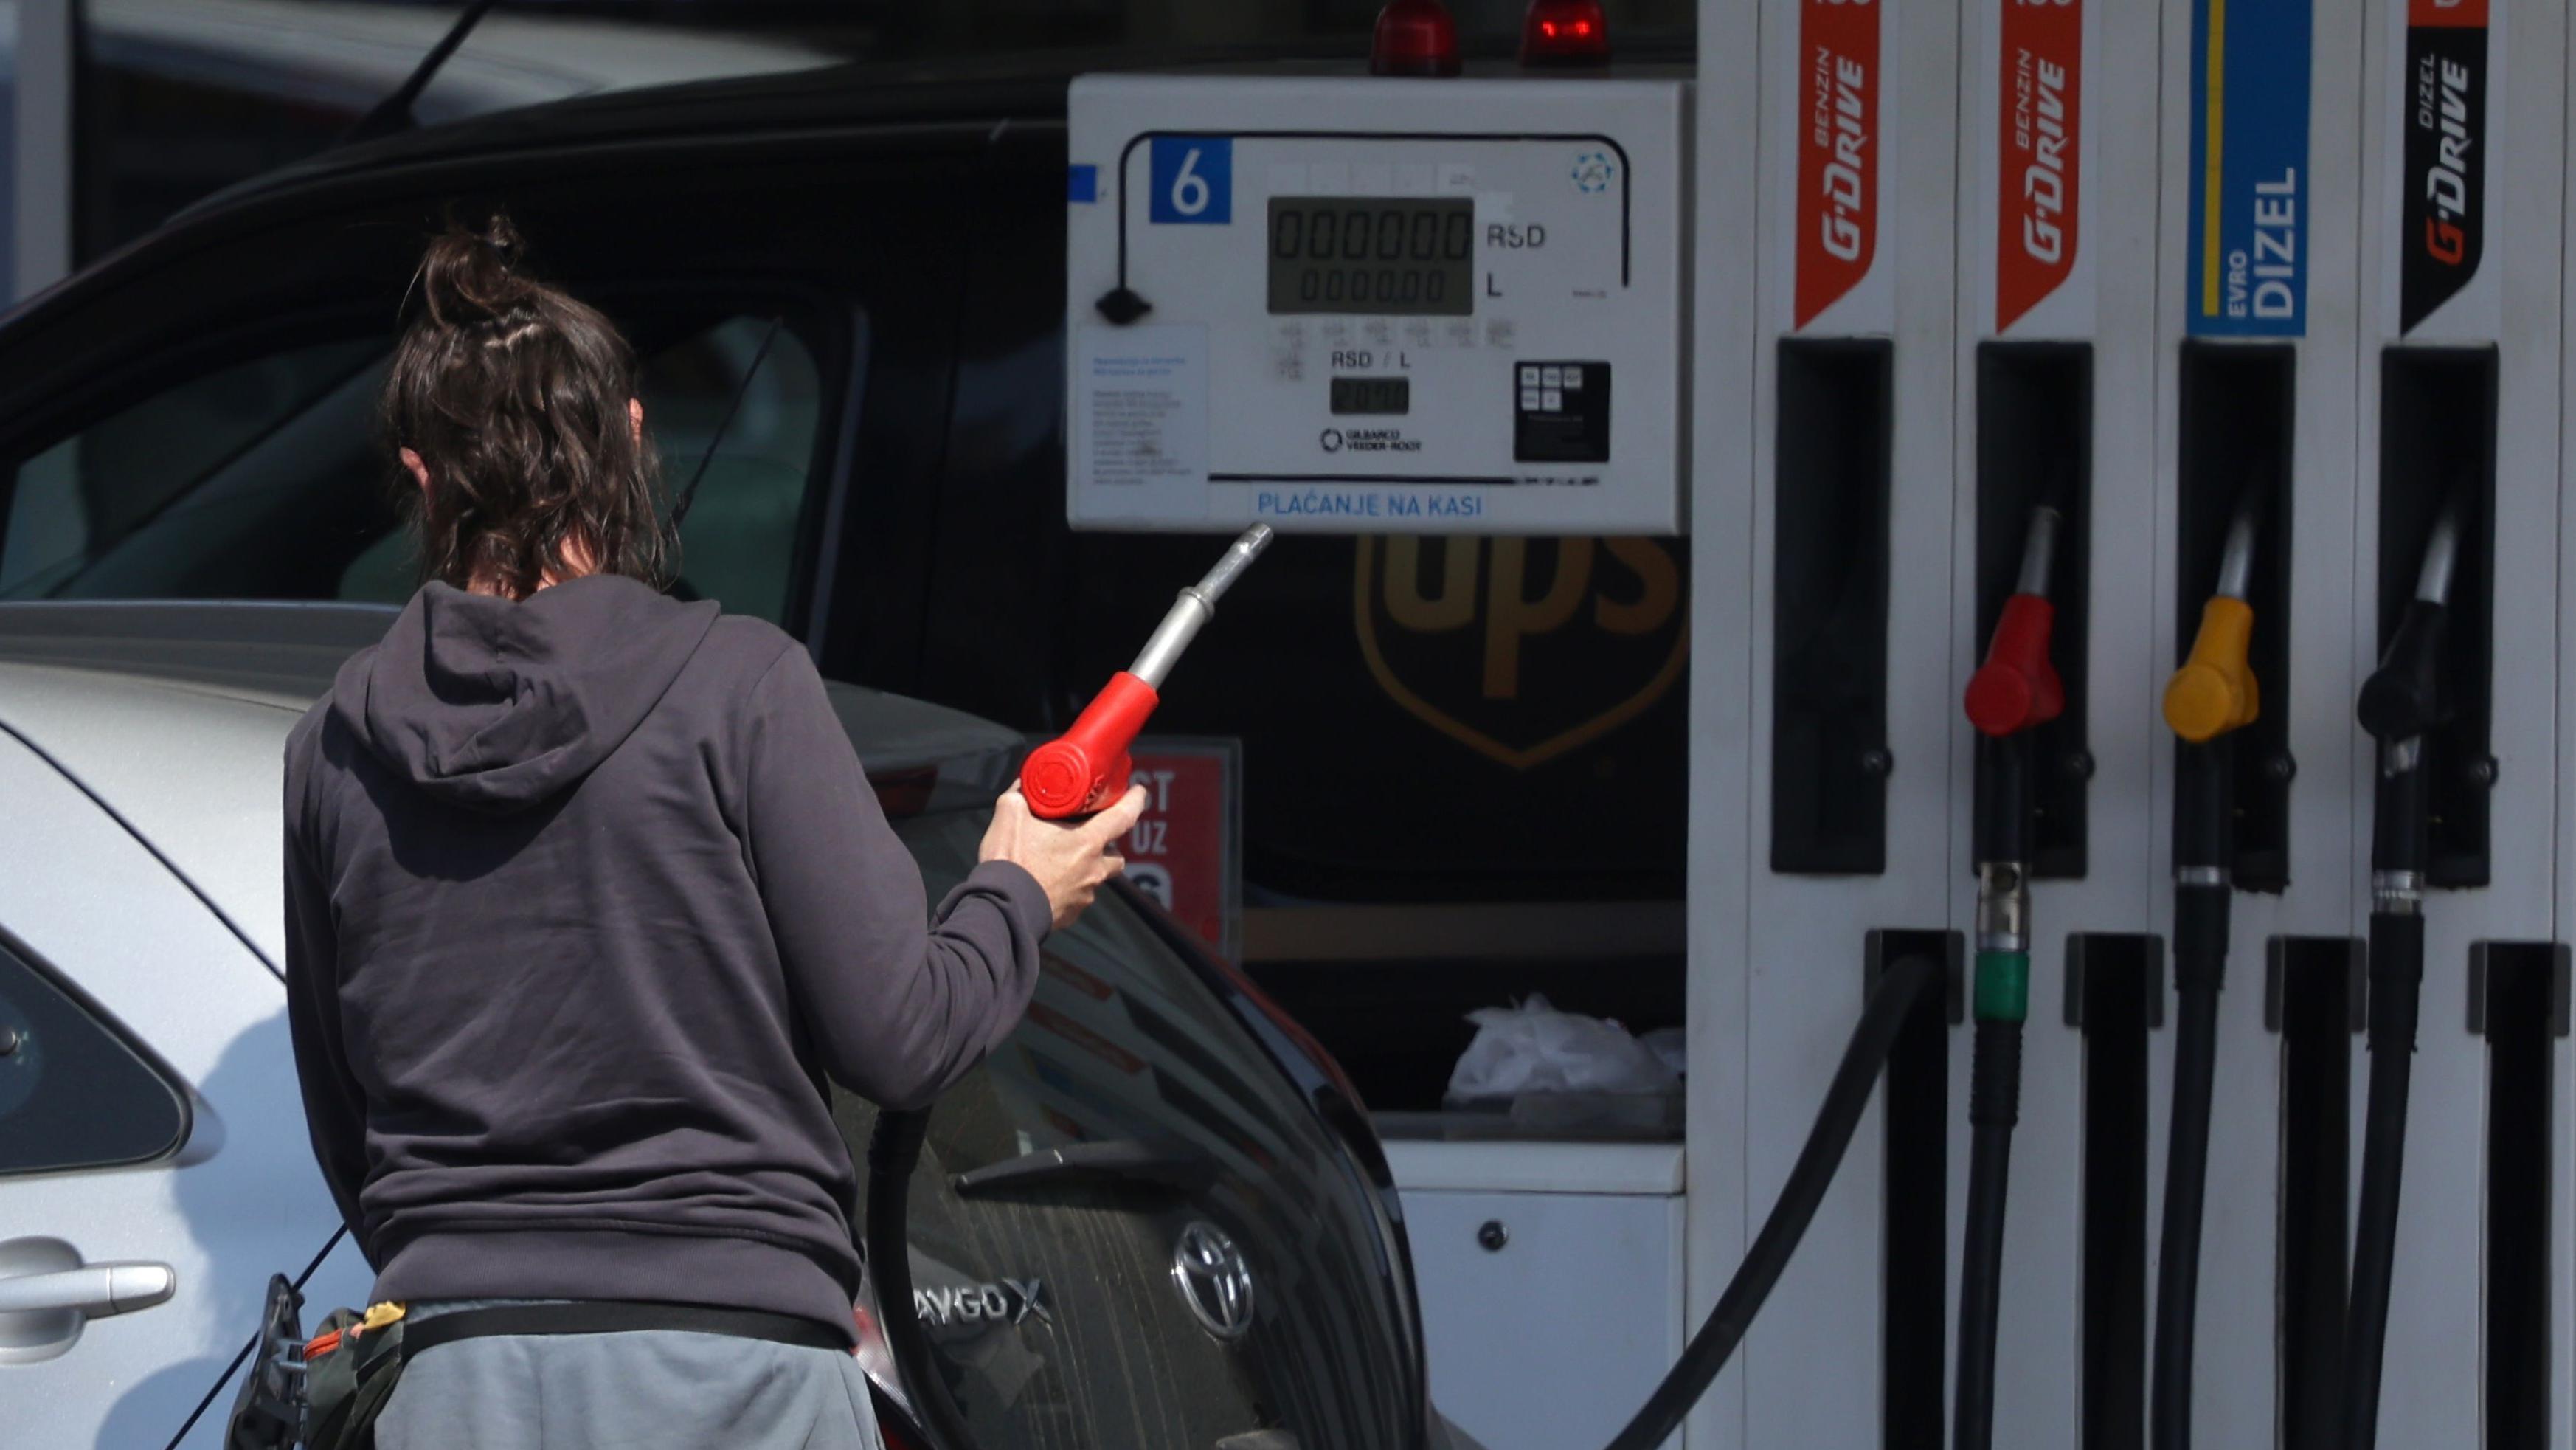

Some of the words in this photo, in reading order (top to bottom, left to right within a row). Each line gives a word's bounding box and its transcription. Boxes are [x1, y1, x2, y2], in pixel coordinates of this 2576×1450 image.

[1815, 45, 1832, 148] BENZIN
[2015, 48, 2032, 151] BENZIN
[2418, 53, 2434, 131] DIZEL
[1171, 148, 1210, 215] 6
[1275, 210, 1472, 260] 000000
[1487, 224, 1545, 249] RSD
[2253, 167, 2296, 320] DIZEL
[1487, 272, 1502, 297] L
[2227, 249, 2248, 320] EVRO
[1331, 351, 1373, 369] RSD
[1399, 351, 1410, 368] L
[1258, 488, 1379, 516] PLAĆANJE
[1388, 495, 1422, 516] NA
[1428, 494, 1482, 516] KASI
[1132, 821, 1168, 855] UZ
[912, 1283, 1008, 1327] AYGO
[1001, 1277, 1053, 1325] X
